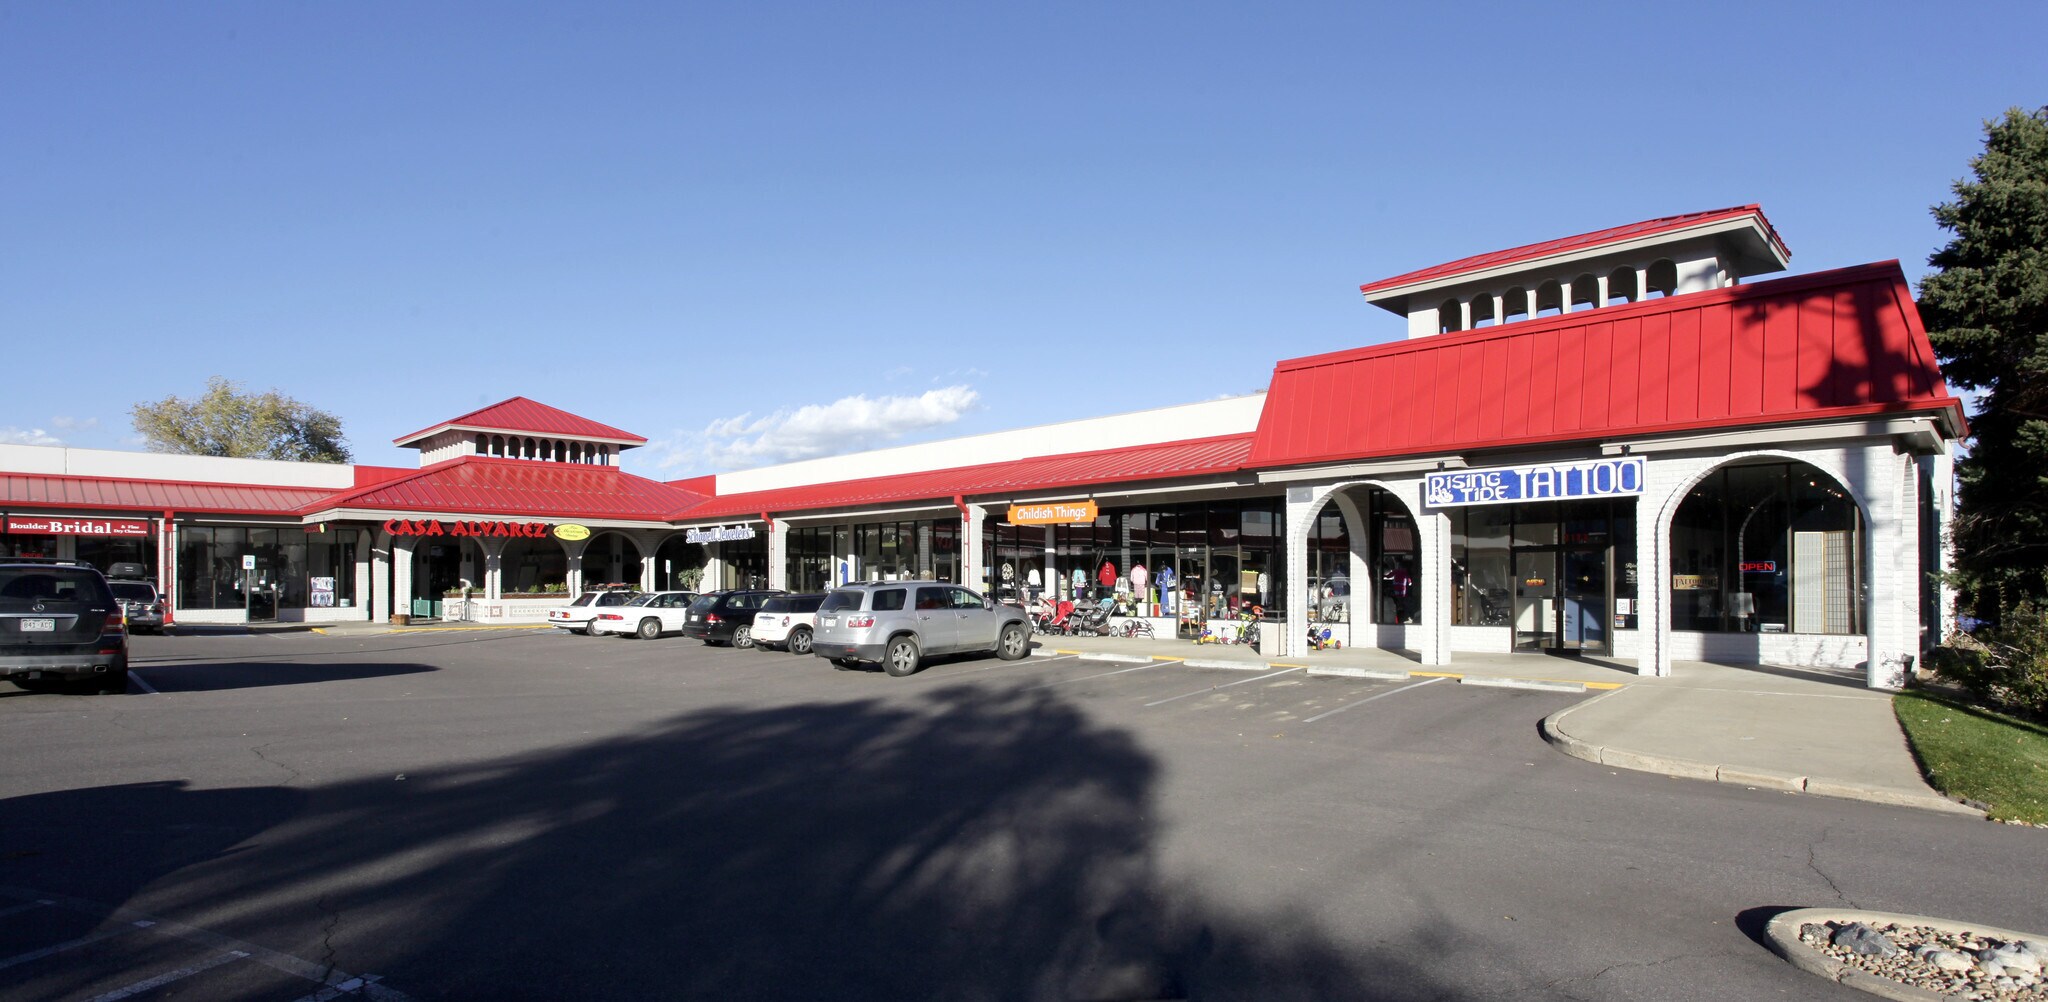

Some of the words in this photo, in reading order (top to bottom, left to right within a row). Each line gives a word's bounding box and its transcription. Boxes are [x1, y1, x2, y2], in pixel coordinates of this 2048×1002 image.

[1513, 459, 1642, 499] TATTOO
[1461, 485, 1509, 501] TIDE
[1017, 508, 1053, 520] Childish
[1055, 506, 1087, 520] Things
[10, 522, 48, 531] Boulder
[49, 521, 112, 534] Bridal
[383, 518, 445, 537] CASA
[450, 519, 548, 539] ALVAREZ
[717, 525, 751, 542] Jewelers
[1739, 562, 1774, 571] OPEN
